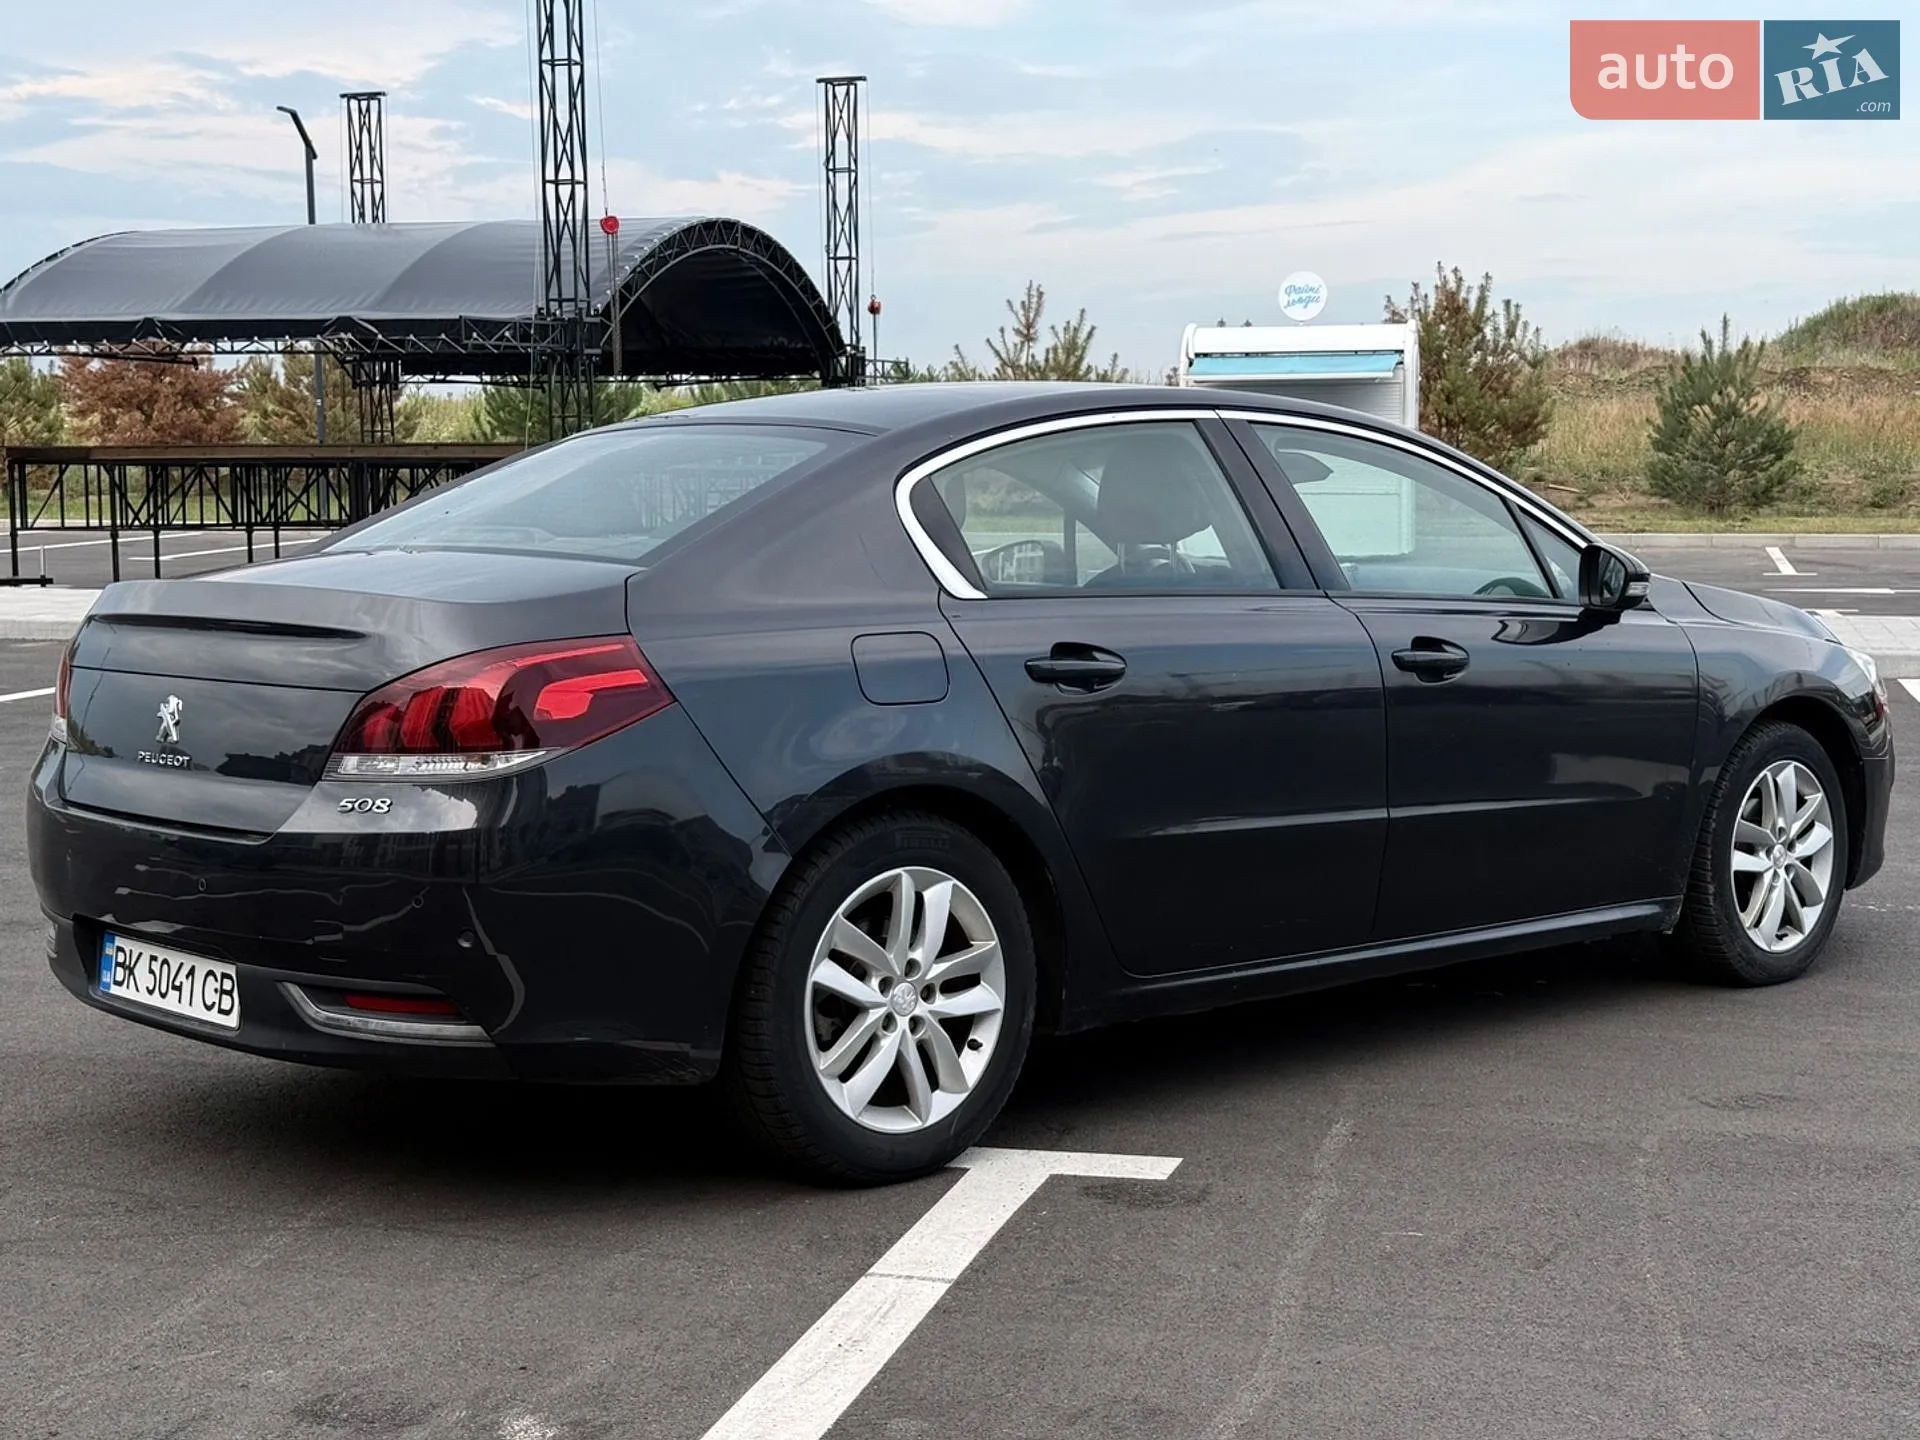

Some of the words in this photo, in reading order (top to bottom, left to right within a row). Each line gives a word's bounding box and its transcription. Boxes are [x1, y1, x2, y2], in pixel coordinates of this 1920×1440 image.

[137, 750, 191, 768] PEUGEOT
[337, 798, 392, 814] 508
[113, 945, 143, 993] BK
[145, 954, 196, 1007] 5041
[202, 969, 235, 1016] CB
